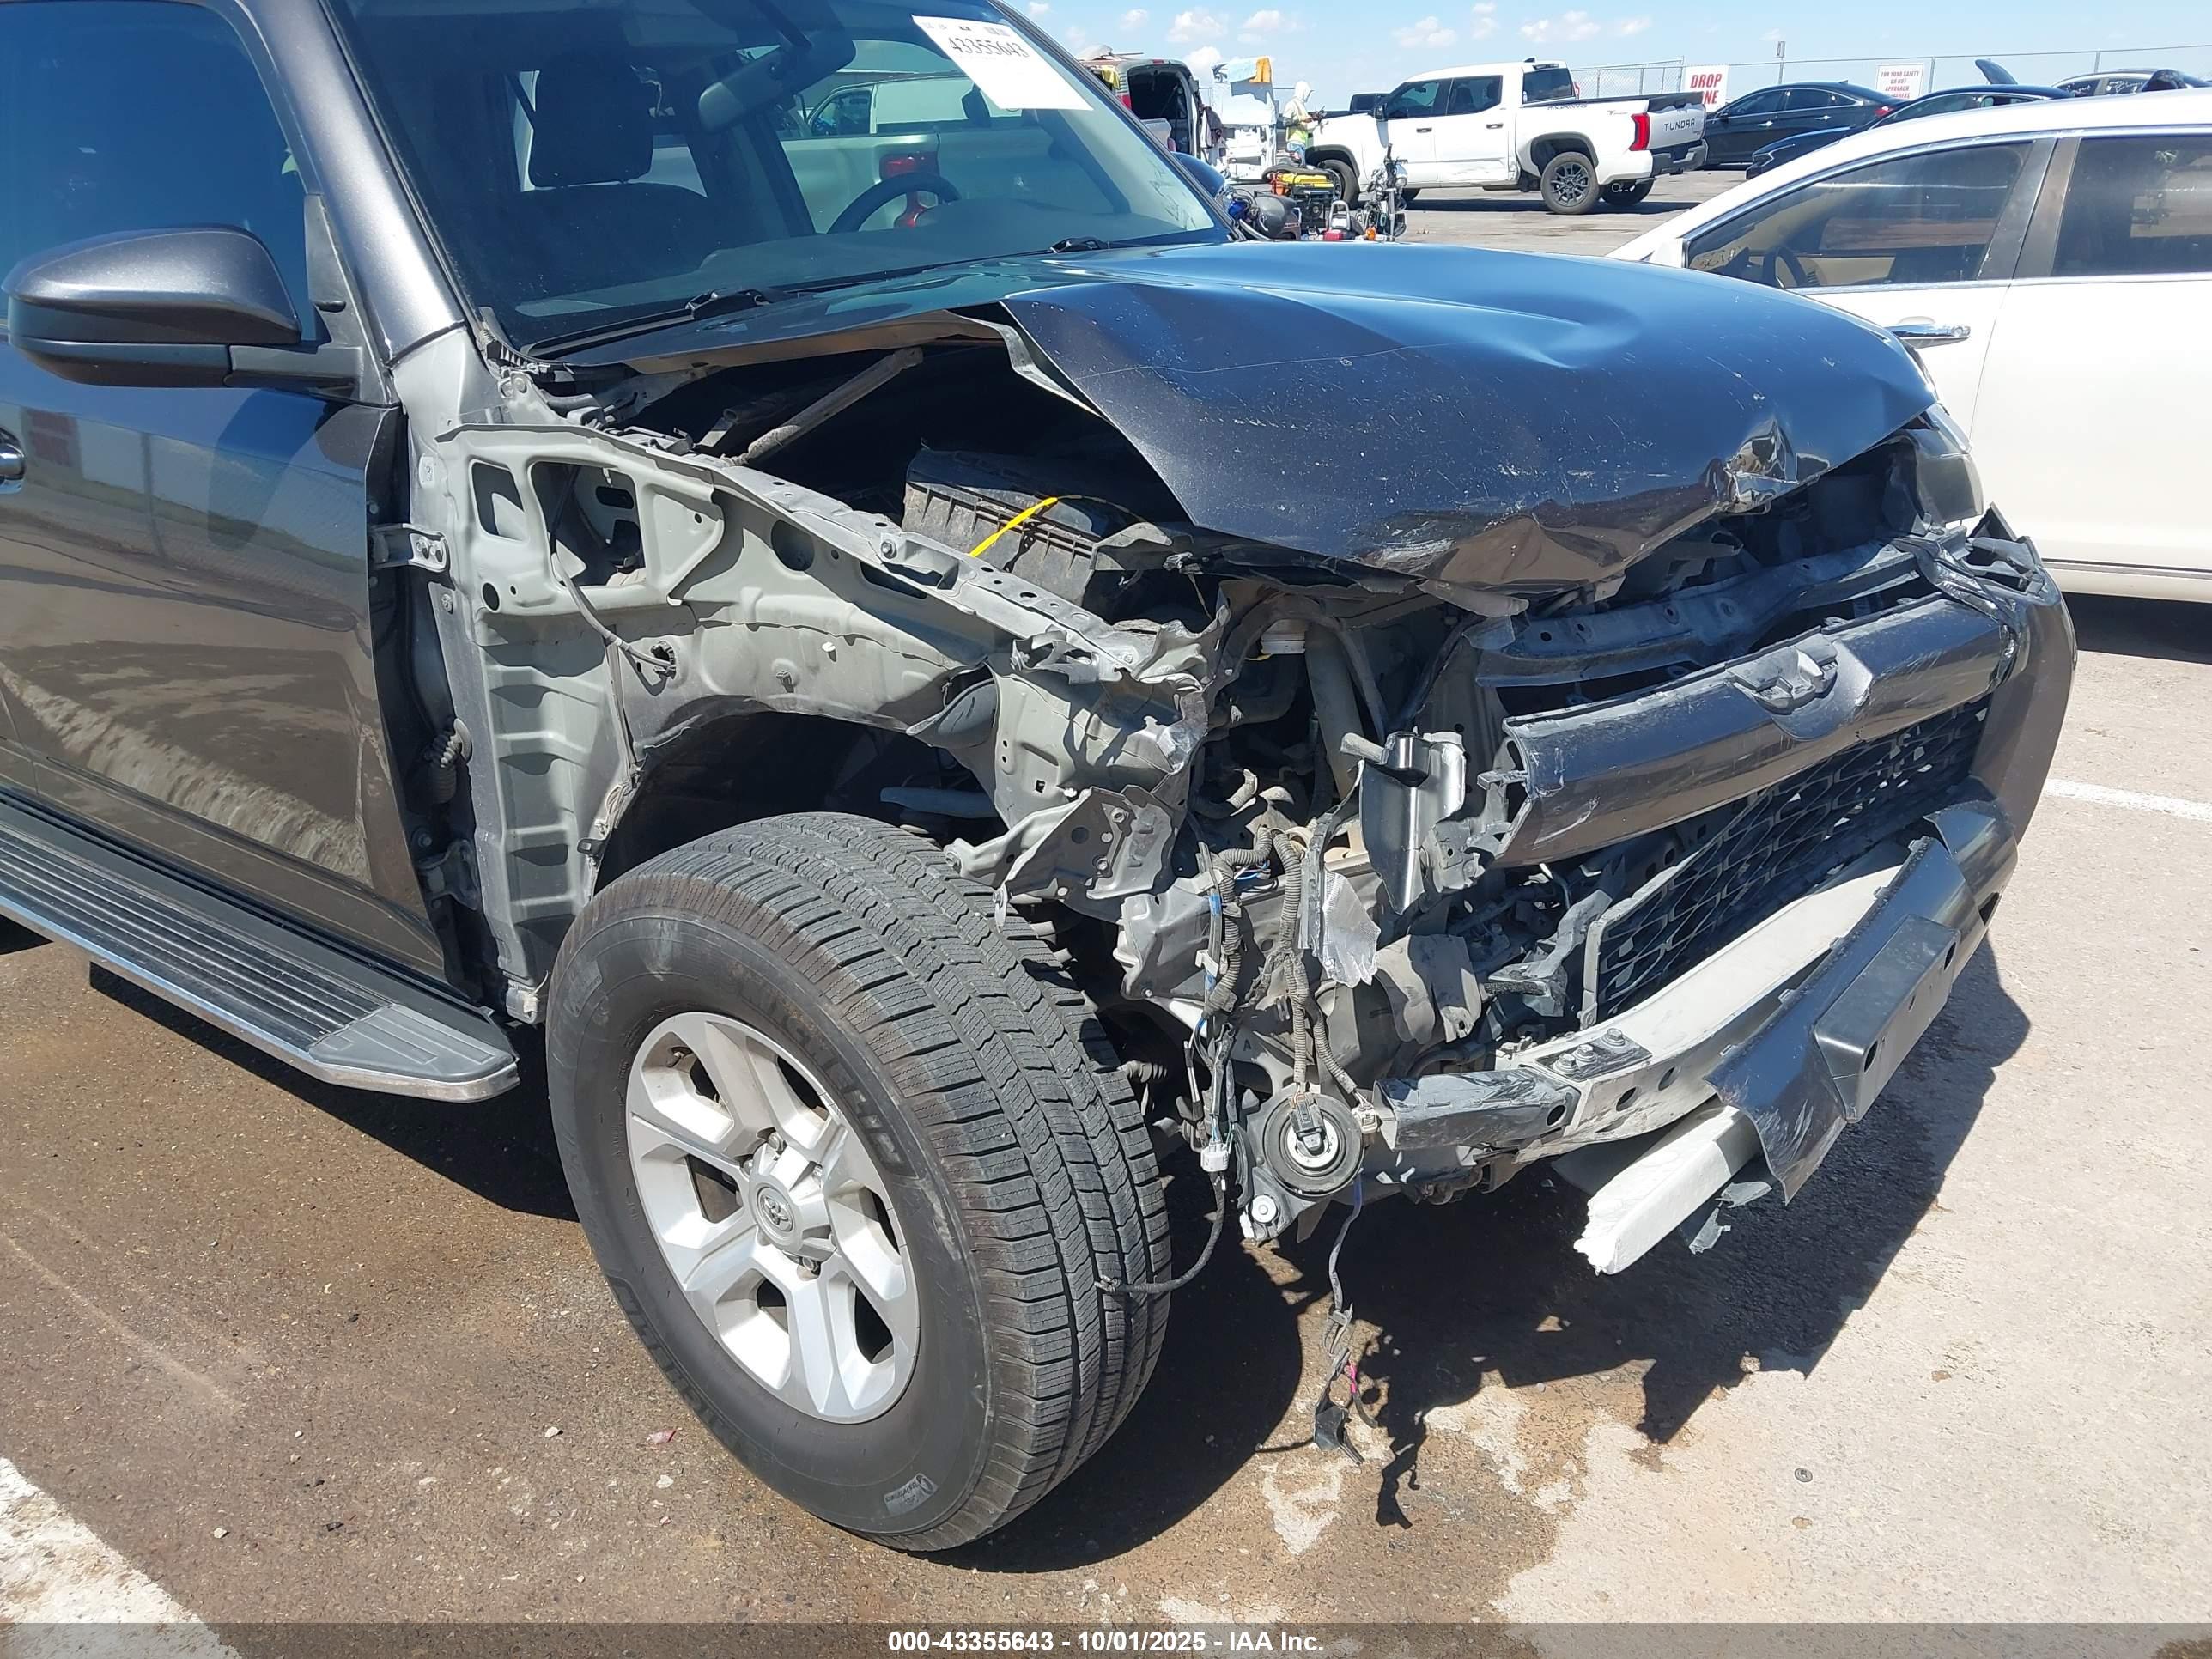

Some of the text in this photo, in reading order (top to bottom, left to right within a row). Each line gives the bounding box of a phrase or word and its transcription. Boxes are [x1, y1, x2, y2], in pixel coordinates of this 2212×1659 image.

[948, 37, 1029, 58] 43355643
[1690, 74, 1723, 88] DROP
[1663, 118, 1696, 131] TUNDRA
